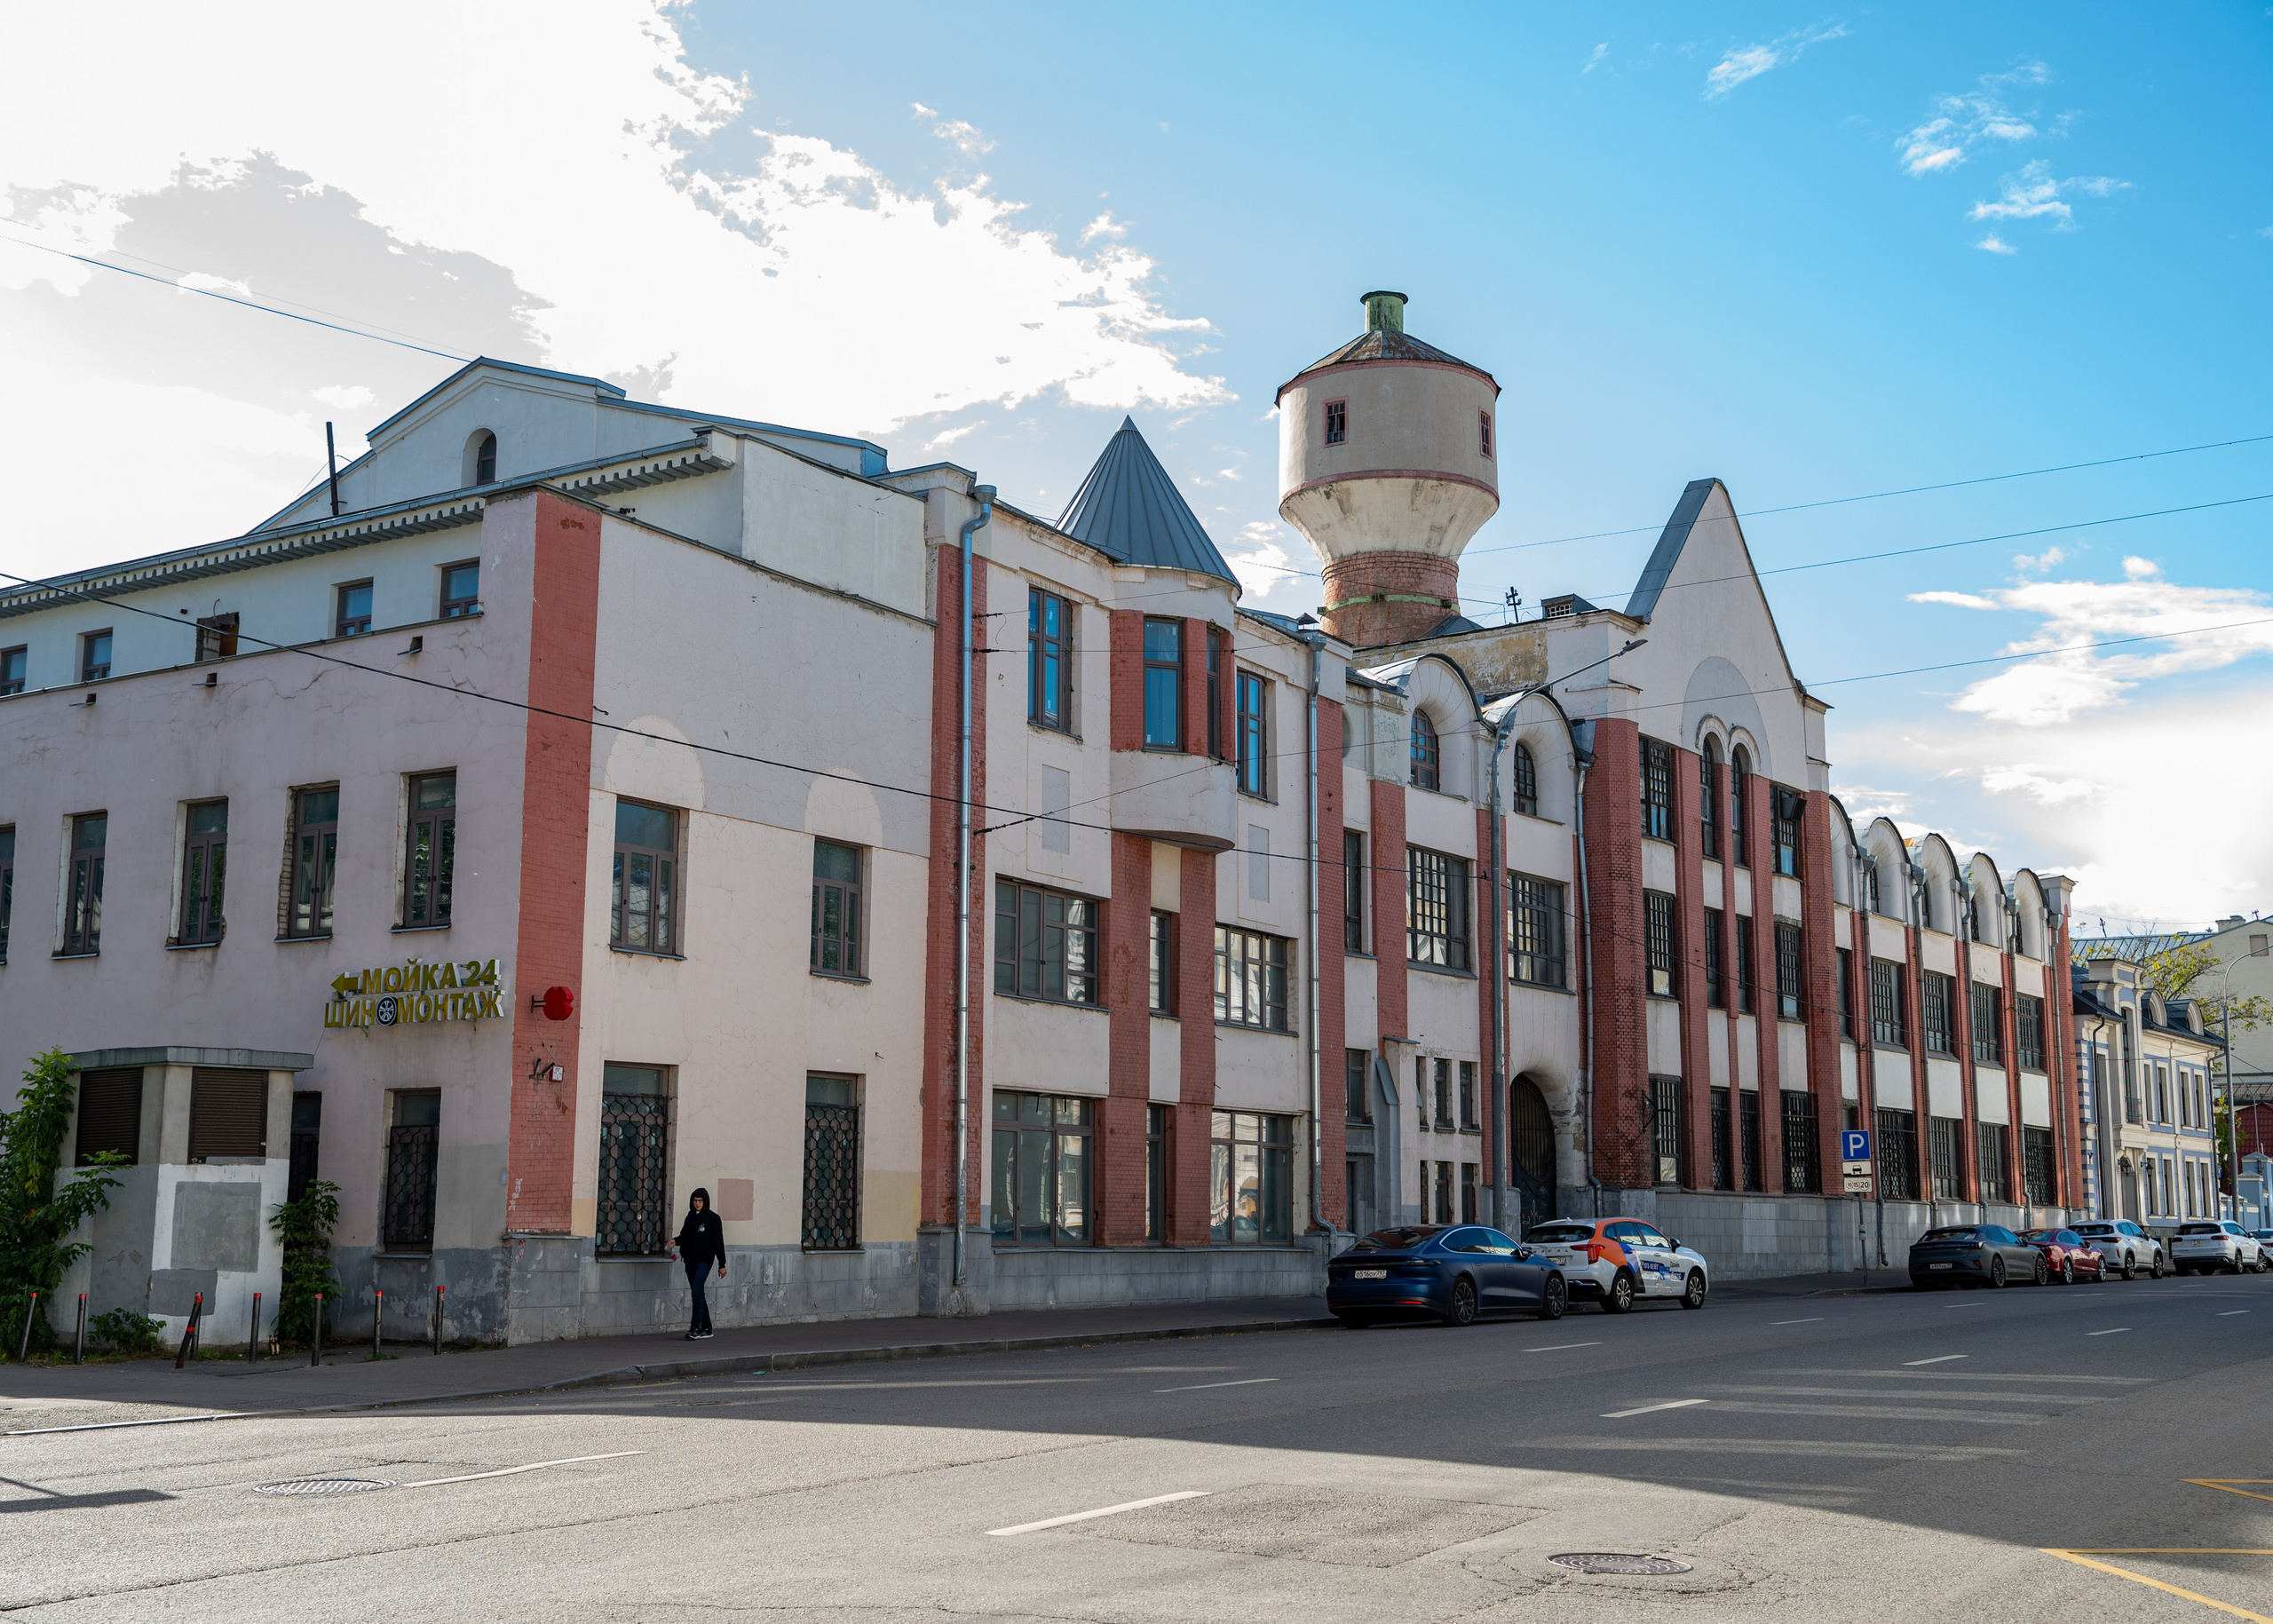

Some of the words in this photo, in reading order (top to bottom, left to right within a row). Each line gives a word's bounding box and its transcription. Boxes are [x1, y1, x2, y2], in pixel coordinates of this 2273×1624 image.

[361, 958, 460, 994] МОЙКА
[464, 959, 500, 988] 24
[1849, 1134, 1865, 1157] P
